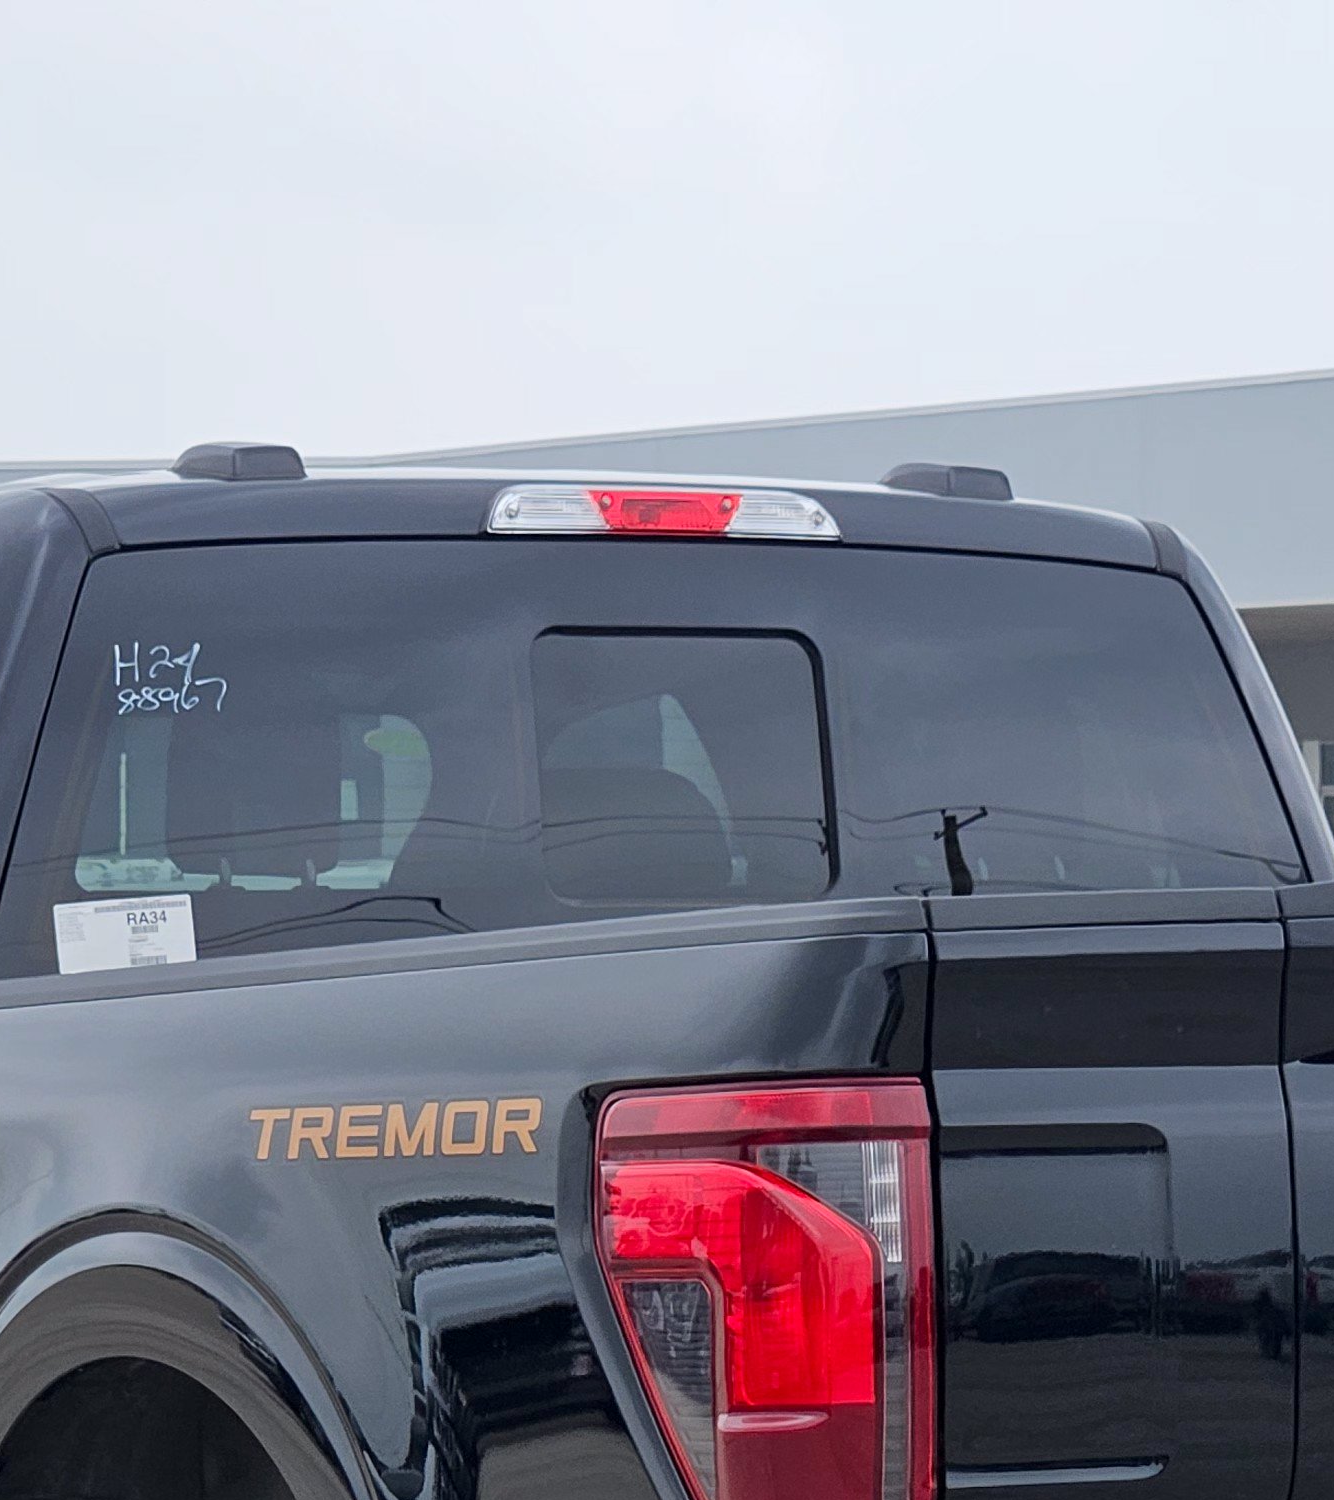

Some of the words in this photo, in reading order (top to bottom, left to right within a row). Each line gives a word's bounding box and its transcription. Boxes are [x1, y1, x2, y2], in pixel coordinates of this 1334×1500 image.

[118, 677, 227, 715] 88967
[127, 910, 167, 926] RA34
[249, 1097, 543, 1160] TREMOR
